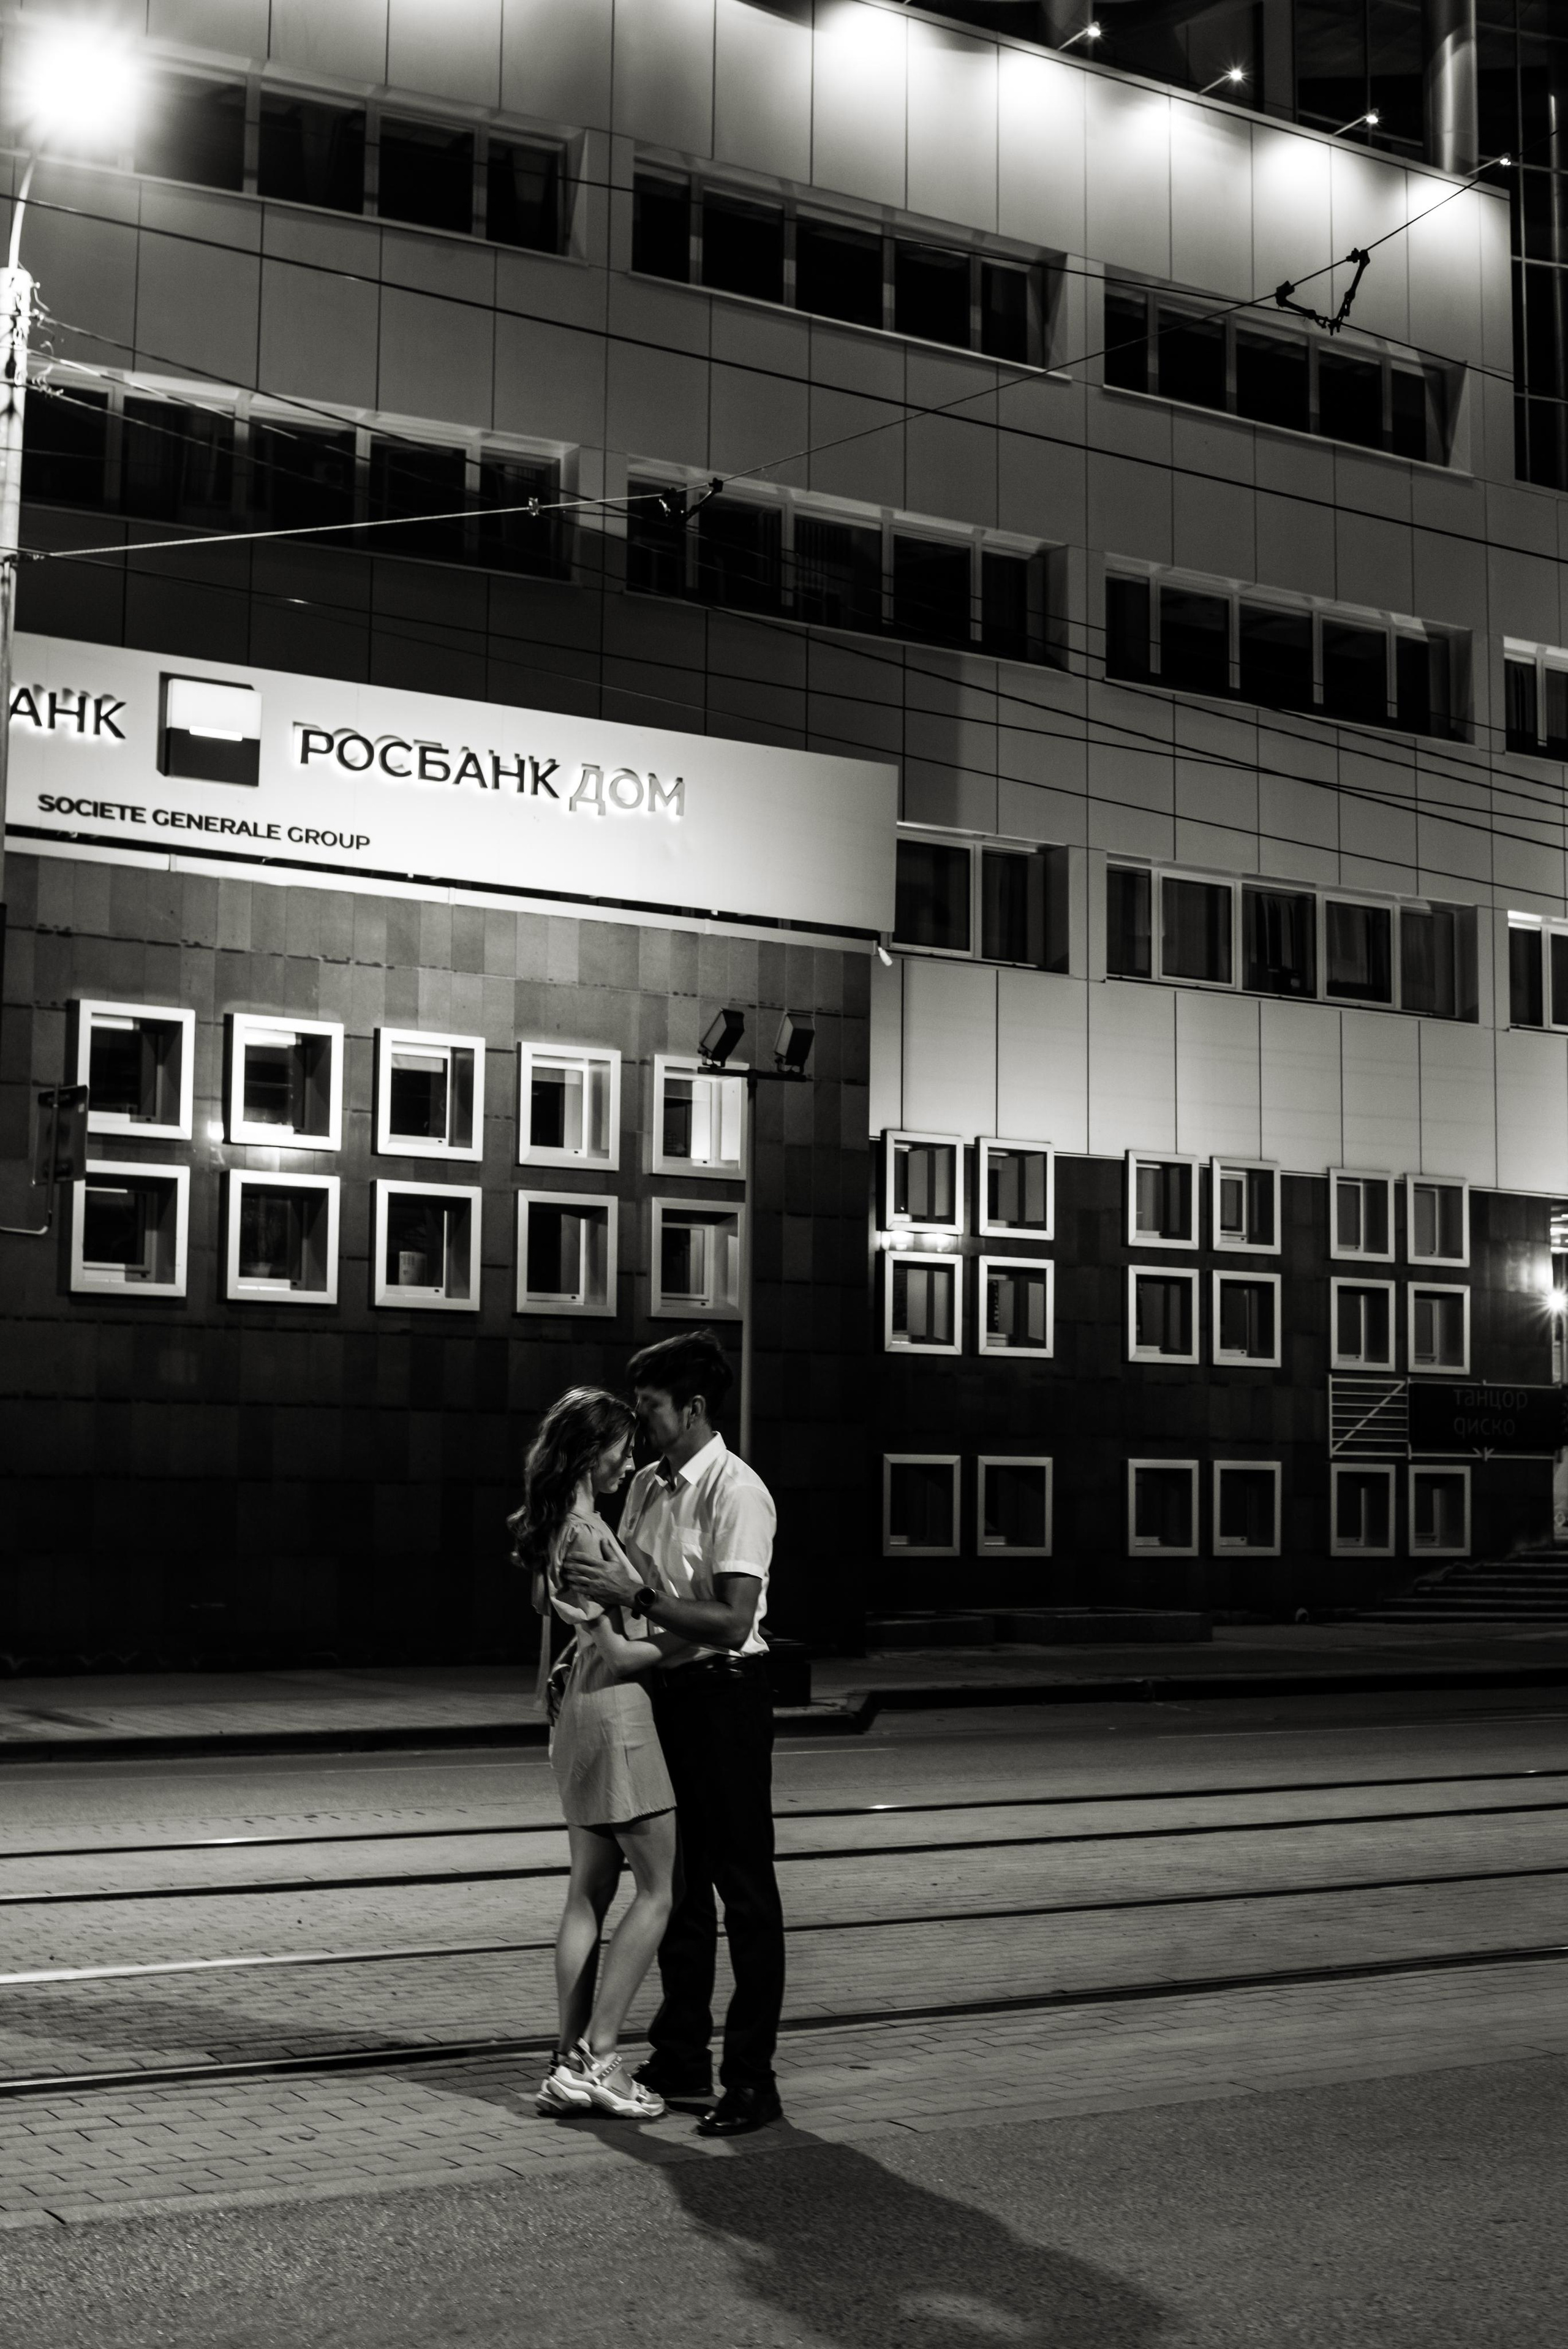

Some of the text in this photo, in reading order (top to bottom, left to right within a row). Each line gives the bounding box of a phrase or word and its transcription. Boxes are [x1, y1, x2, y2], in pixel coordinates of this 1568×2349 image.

[299, 728, 686, 817] РОСБАНК ДОМ
[37, 794, 371, 850] SOCIETE GENERALE GROUP
[1453, 1388, 1528, 1411] танцор
